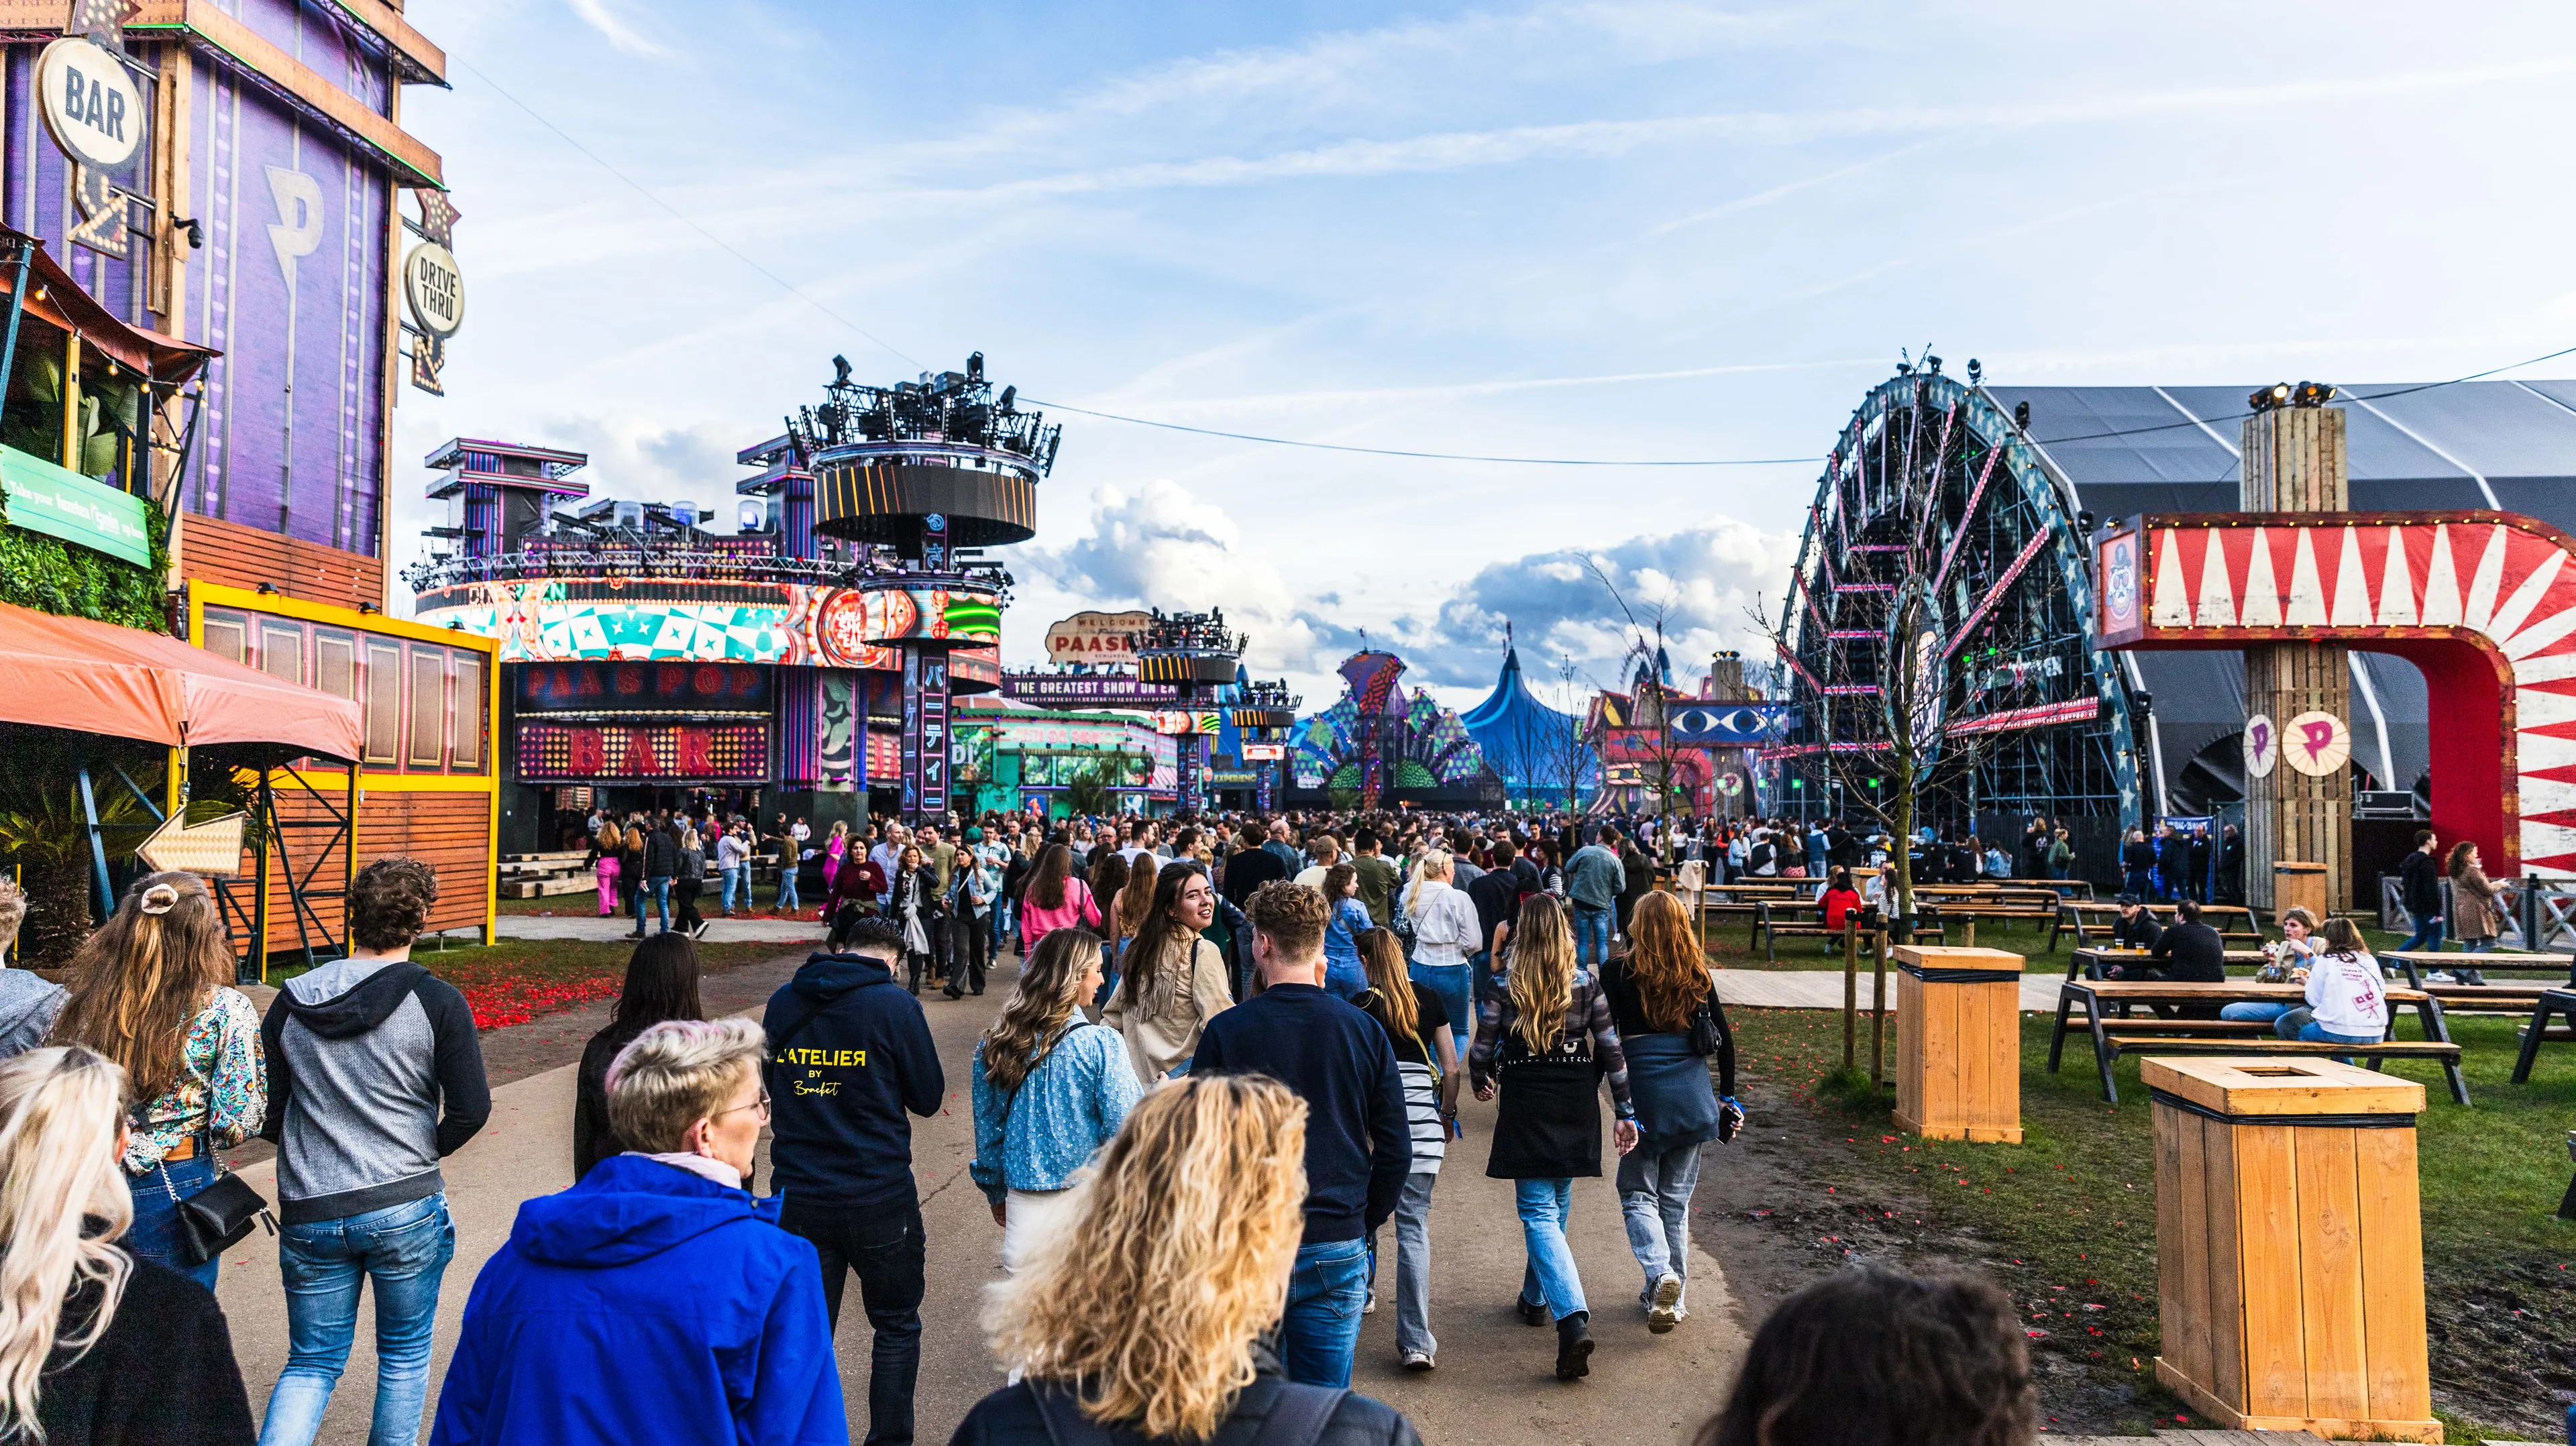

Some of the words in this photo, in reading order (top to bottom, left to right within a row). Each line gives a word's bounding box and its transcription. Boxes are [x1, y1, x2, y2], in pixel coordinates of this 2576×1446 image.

[66, 65, 125, 144] BAR
[421, 257, 456, 298] DRIVE
[422, 284, 453, 321] THRU
[1014, 681, 1034, 693] THE
[1040, 681, 1098, 693] GREATEST
[1104, 681, 1136, 693] SHOW
[1141, 683, 1156, 693] ON
[570, 727, 714, 773] BAR
[1214, 774, 1257, 783] EXPERIENC
[808, 1070, 822, 1078] BY
[794, 1080, 842, 1097] Bracket
